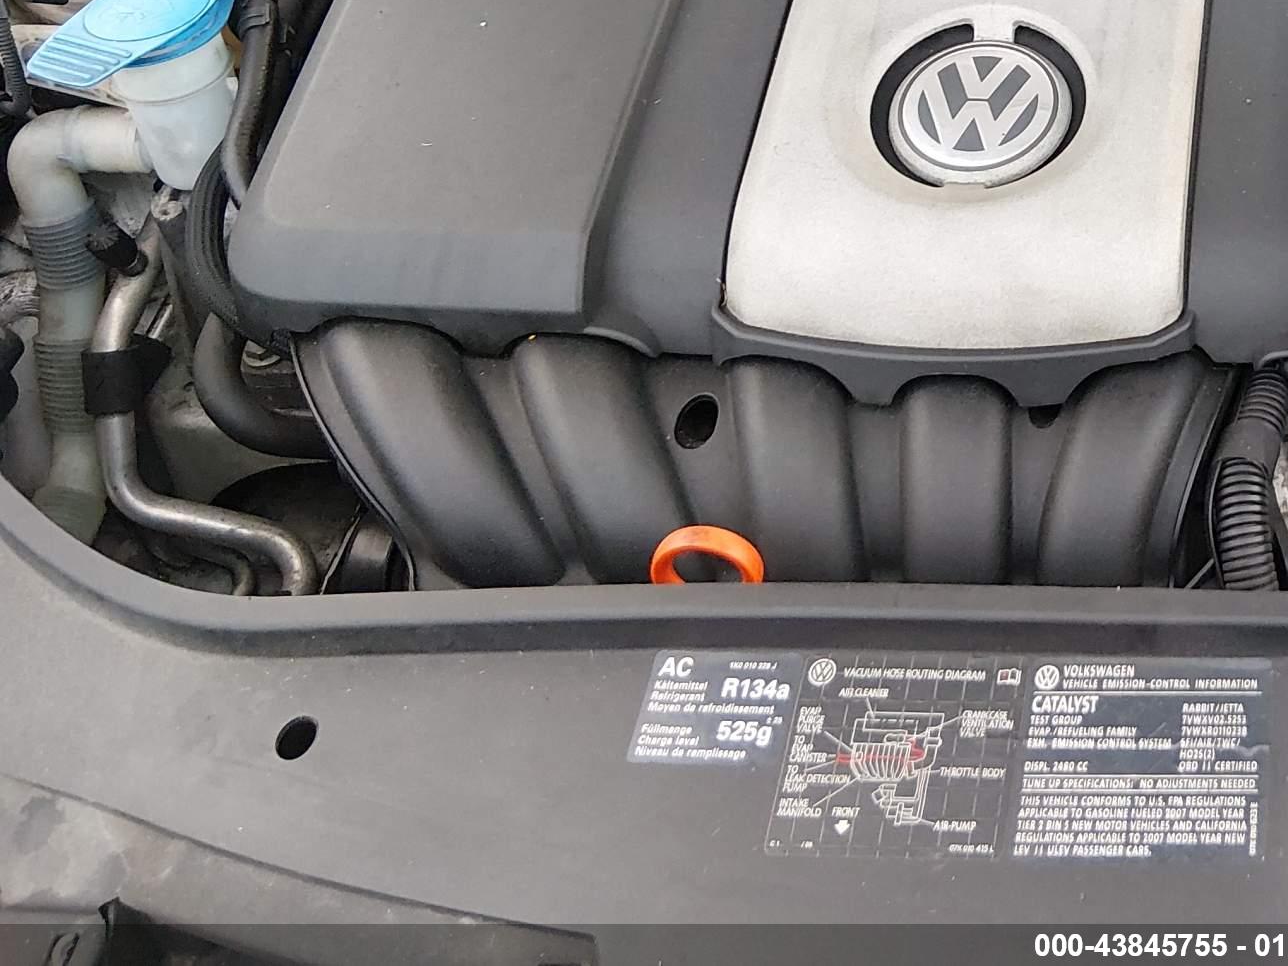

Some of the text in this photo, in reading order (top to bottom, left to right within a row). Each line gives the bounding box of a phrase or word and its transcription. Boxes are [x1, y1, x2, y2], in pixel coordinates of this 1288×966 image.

[658, 656, 694, 677] AC
[1064, 664, 1135, 678] VOLKSWAGEN
[844, 667, 986, 682] VACUUM HOSE ROUTING DIAGRAM
[654, 680, 708, 691] Kältemittel
[720, 678, 790, 700] R134a
[1062, 678, 1098, 690] VEHICLE
[1194, 679, 1258, 690] INFORMATION
[650, 690, 706, 702] Refrigerant
[647, 702, 774, 715] Moyen de refroidissement
[1032, 695, 1099, 714] CATALYST
[1182, 703, 1244, 714] RABBIT/JETTA
[960, 719, 1014, 730] VENTILATION
[1030, 715, 1082, 726] TEST GROUP
[641, 723, 693, 736] Füllmenge
[796, 723, 822, 733] VALVE
[960, 728, 985, 738] VALVE
[1106, 726, 1137, 736] FAMILY
[716, 720, 774, 748] 525g
[794, 735, 806, 744] TO
[638, 734, 700, 747] Charge level
[1052, 738, 1172, 750] EMISSION CONTROL SYSTEM
[634, 746, 746, 760] Niveau de remplissage
[789, 752, 828, 762] CANISTER
[787, 765, 799, 774] TO
[940, 766, 1006, 778] THROTTLE BODY
[1024, 761, 1088, 773] DISPL. 2480 CC
[1178, 761, 1258, 772] OBD CERTIFIED
[784, 774, 851, 784] LEAK DETECTION
[1022, 778, 1046, 788] TUNE
[1048, 778, 1060, 788] UP
[1140, 778, 1154, 788] NO
[1156, 779, 1218, 788] ADJUSTMENTS
[1220, 779, 1256, 789] NEEDED
[782, 782, 808, 792] PUMP
[780, 798, 809, 807] INTAKE
[1020, 796, 1040, 806] THIS
[1043, 796, 1078, 806] VEHICLE
[1080, 796, 1132, 806] CONFORMS
[1134, 796, 1146, 806] TO
[1186, 796, 1246, 806] REGULATIONS
[776, 808, 822, 818] MANIFOLD
[832, 807, 860, 817] FRONT
[1018, 808, 1244, 818] APPLICABLE TO GASOLINE FUELED 2007 MODEL YEAR
[932, 820, 976, 832] AIR-PUMP
[1017, 820, 1036, 831] TIER
[1046, 820, 1062, 831] BIN
[1072, 820, 1092, 831] NEW
[1095, 820, 1128, 831] MOTOR
[1130, 820, 1170, 831] VEHICLES
[1172, 820, 1192, 831] AND
[1195, 820, 1247, 832] CALIFORNIA
[1014, 832, 1246, 844] REGULATIONS APPLICABLE TO 2007 MODEL YEAR NEW
[1014, 844, 1152, 857] LEV ULEV PASSENGER CARS.
